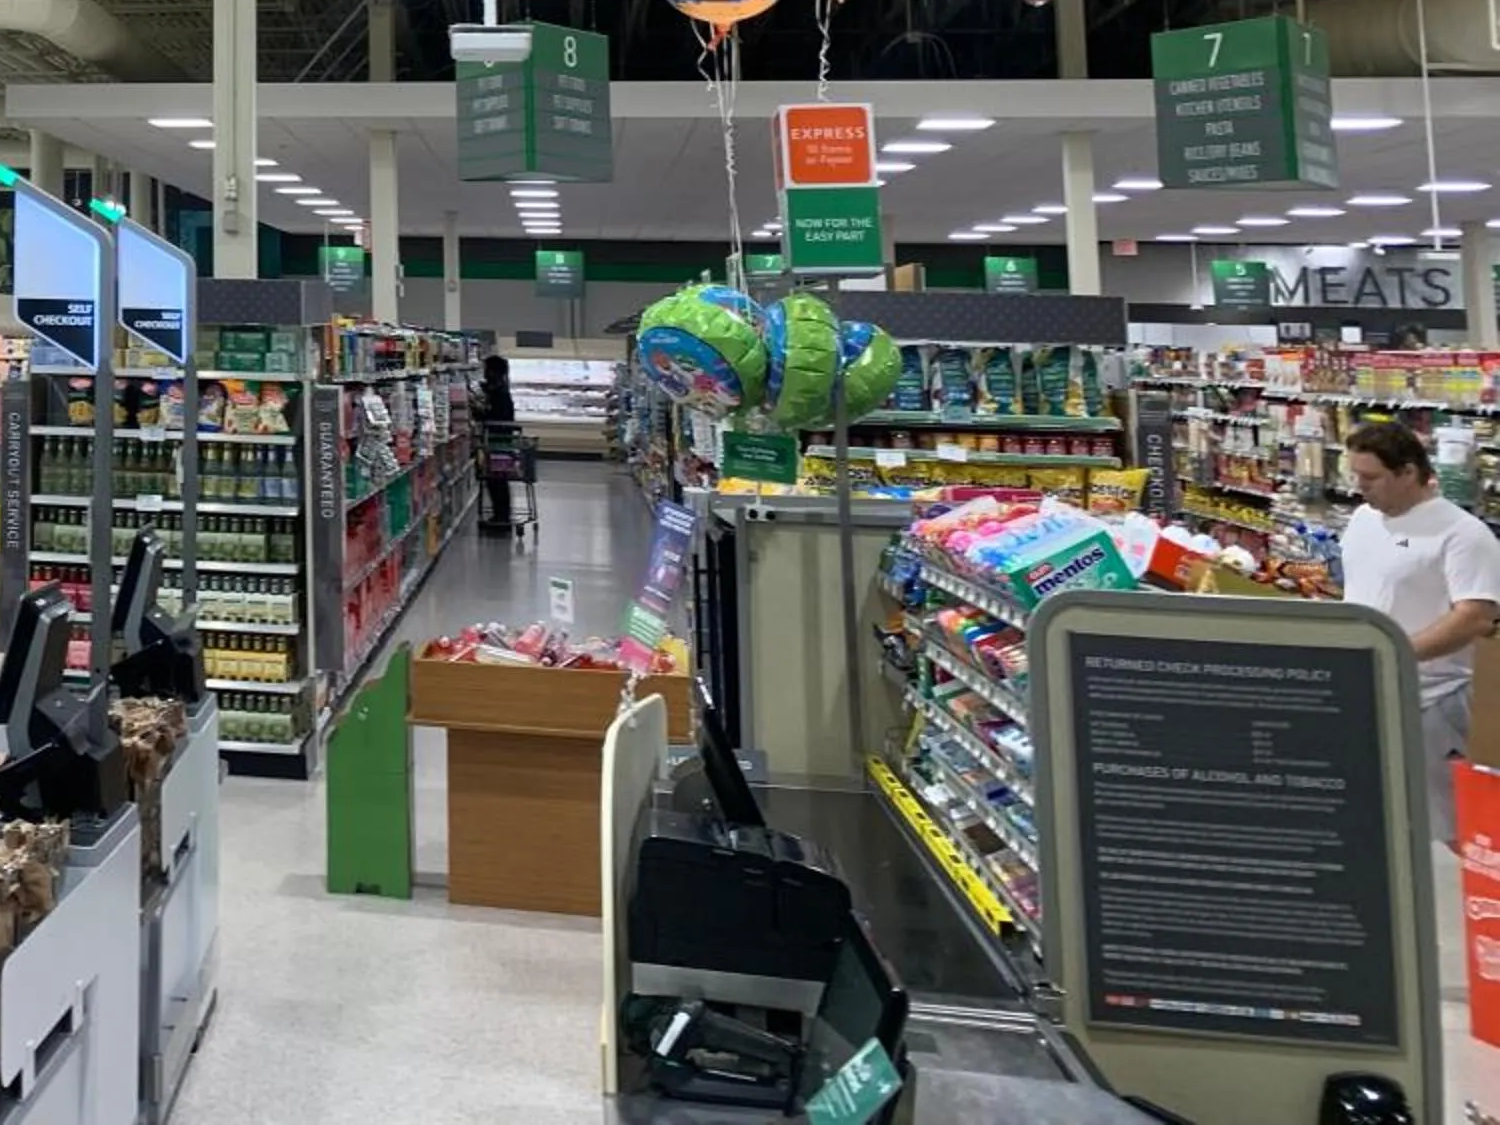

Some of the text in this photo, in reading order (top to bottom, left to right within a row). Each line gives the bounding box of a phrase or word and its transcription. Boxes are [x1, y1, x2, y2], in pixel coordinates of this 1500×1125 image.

[563, 35, 578, 68] 8
[1203, 32, 1223, 68] 7
[791, 126, 866, 141] EXPRESS
[795, 217, 872, 228] NOW FOR THE
[805, 228, 866, 243] EASY PART
[1272, 266, 1453, 308] MEATS
[33, 314, 93, 326] CHECKOUT
[67, 303, 93, 314] SELF
[6, 411, 21, 549] CARRYOUT SERVICE
[319, 421, 335, 519] GUARANTEED
[1034, 547, 1106, 595] mentos
[1085, 655, 1332, 682] RETURNED CHECK PROCESSING POLICY
[1092, 761, 1347, 791] PURCHASES OF ALCOHOL AND TOBACCO
